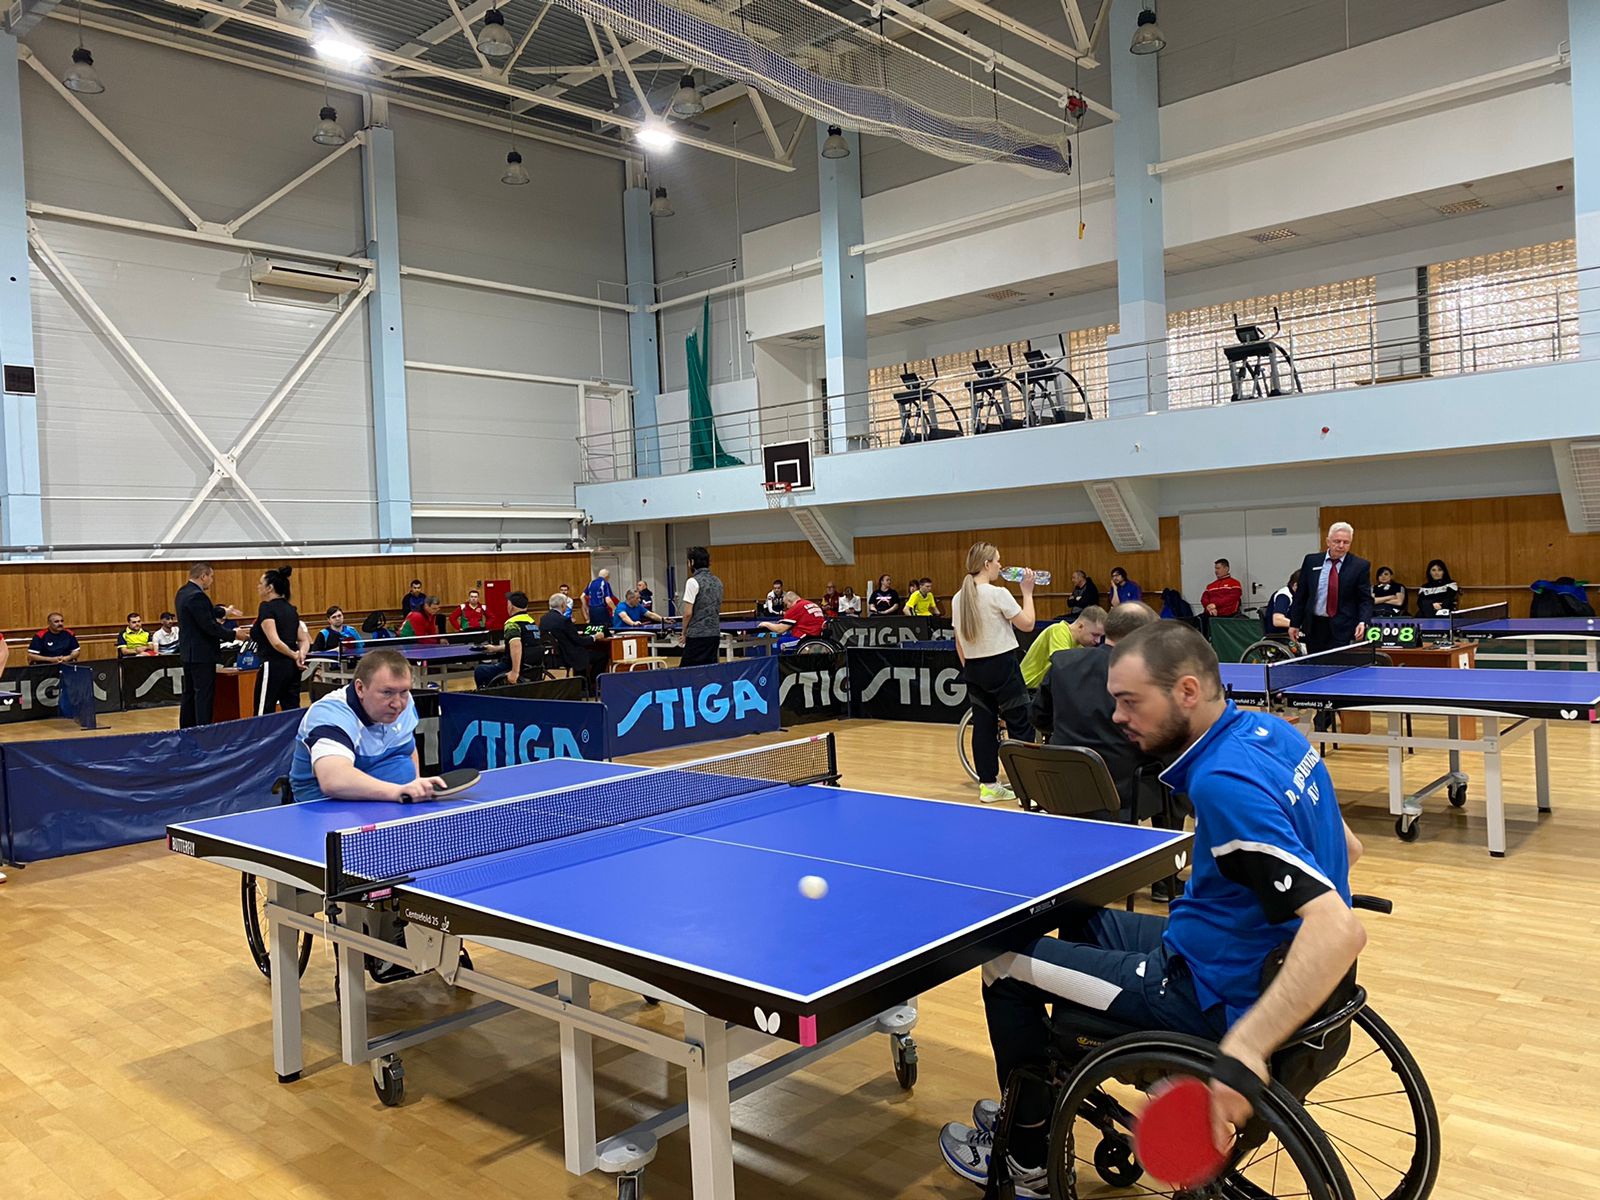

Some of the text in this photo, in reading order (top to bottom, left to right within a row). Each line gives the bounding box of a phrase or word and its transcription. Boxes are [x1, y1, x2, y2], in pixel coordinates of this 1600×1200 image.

[1367, 627, 1382, 641] 6
[1400, 627, 1414, 642] 8
[862, 667, 967, 706] STIG
[404, 908, 432, 925] Centrefold
